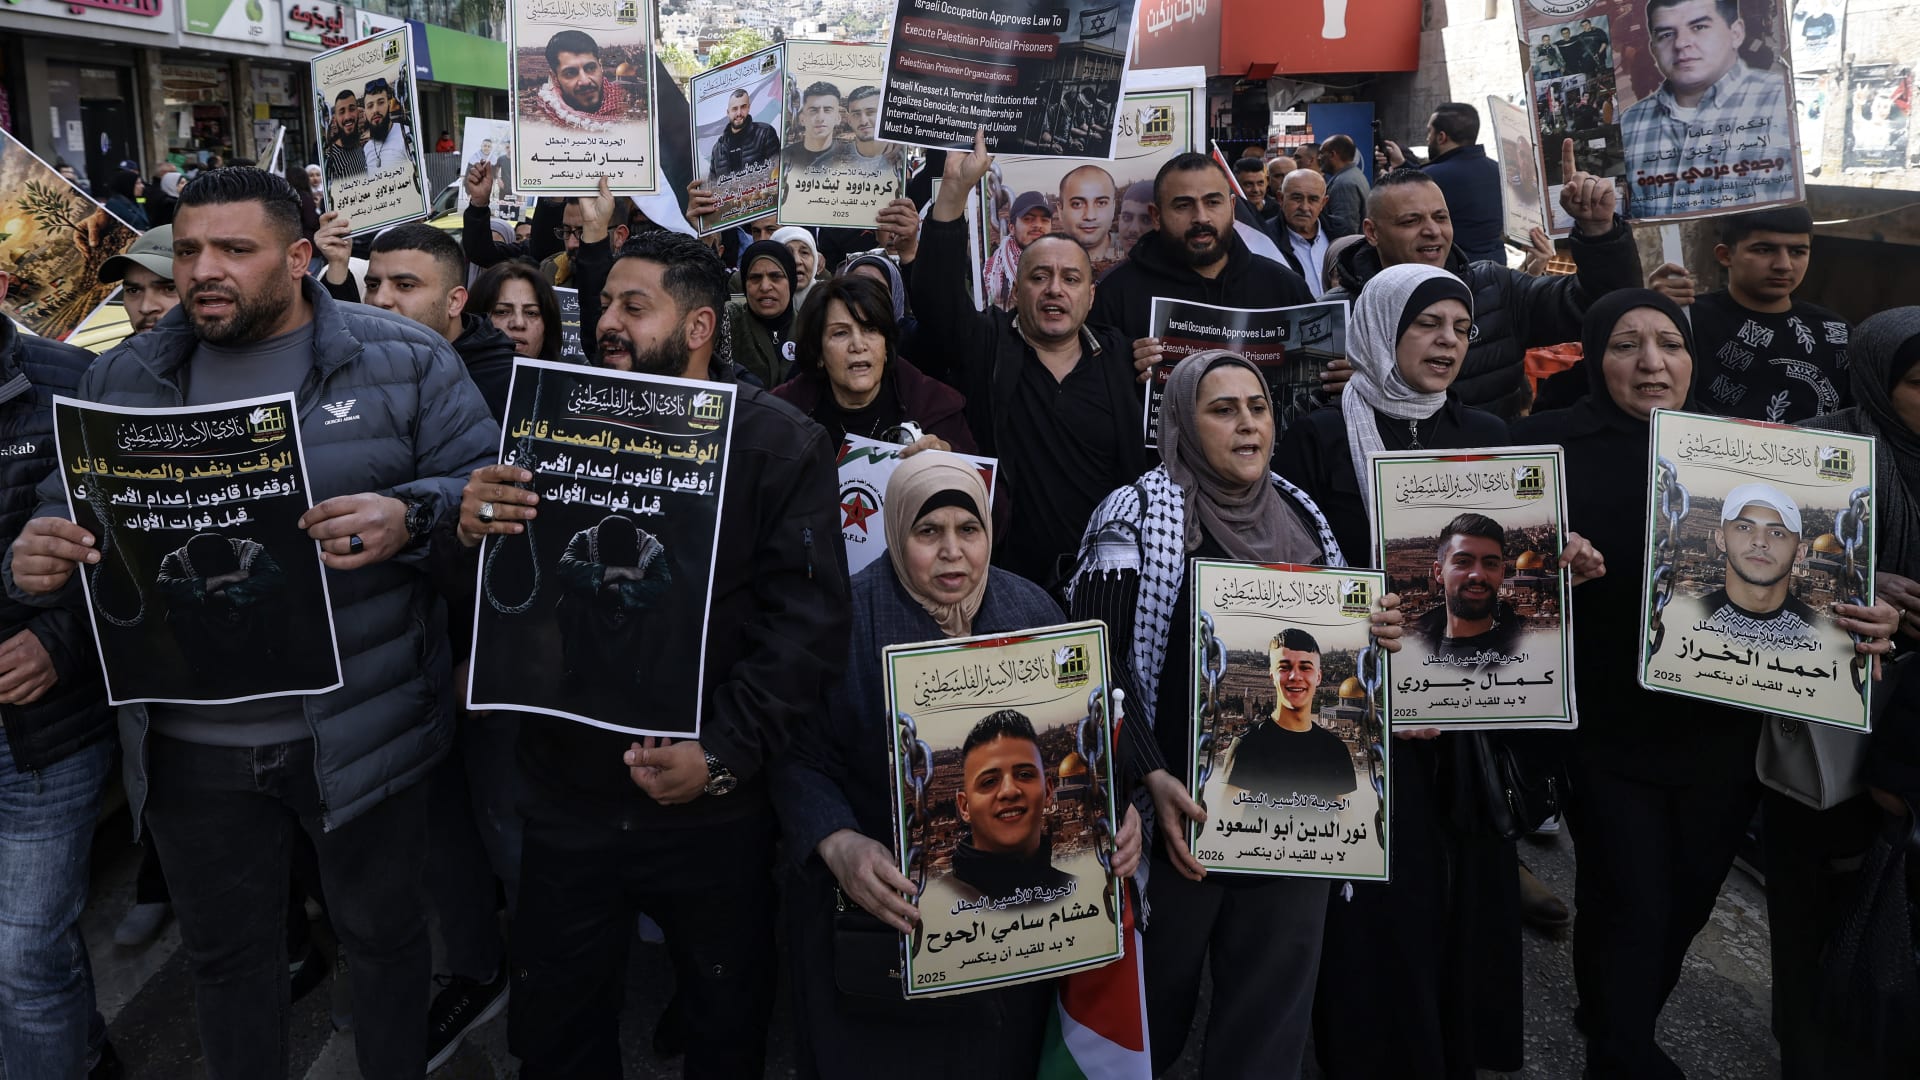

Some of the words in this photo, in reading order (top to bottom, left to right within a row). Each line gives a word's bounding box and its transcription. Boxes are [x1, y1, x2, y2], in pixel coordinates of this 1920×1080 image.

[914, 0, 940, 12] Israeli
[941, 2, 988, 21] Occupation
[989, 13, 1031, 28] Approves
[1033, 14, 1050, 26] Law
[1052, 15, 1062, 26] To
[905, 23, 935, 37] Execute
[936, 28, 979, 46] Palestinian
[980, 36, 1012, 50] Political
[1013, 40, 1053, 52] Prisoners
[900, 56, 934, 72] Palestinian
[935, 62, 964, 76] Prisoner
[964, 66, 1012, 82] Organizations:
[890, 78, 913, 91] Israeli
[914, 82, 942, 96] Knesset
[943, 87, 950, 96] A
[950, 88, 984, 102] Terrorist
[984, 93, 1022, 105] Institution
[1022, 95, 1038, 105] that
[888, 92, 923, 109] Legalizes
[924, 98, 959, 114] Genocide:
[960, 104, 969, 115] its
[970, 104, 1014, 121] Membership
[1016, 110, 1022, 118] in
[886, 108, 933, 124] International
[934, 114, 978, 130] Parliaments
[978, 120, 992, 132] and
[992, 122, 1017, 132] Unions
[1117, 113, 1134, 137] ناد
[884, 121, 901, 133] Must
[902, 124, 913, 135] be
[914, 126, 956, 141] Terminated
[956, 130, 999, 146] Immeately
[530, 152, 596, 166] اشتيه
[599, 152, 644, 166] يسار
[1732, 156, 1784, 176] وجدي
[1636, 170, 1679, 188] جودة
[1681, 159, 1730, 184] عزمي
[523, 178, 542, 186] 2025
[795, 178, 820, 192] داوود
[822, 178, 840, 193] ليث
[846, 180, 870, 194] داوود
[873, 180, 893, 196] كرم
[1169, 318, 1188, 331] Israeli
[1188, 320, 1220, 336] Occupation
[1222, 326, 1260, 340] Approves
[1260, 327, 1276, 338] Law
[1277, 326, 1285, 337] To
[1162, 342, 1184, 354] Execute
[1246, 350, 1280, 361] Prisoners
[9, 442, 36, 456] Rab
[552, 430, 621, 454] والصمت
[624, 436, 663, 458] ينفد
[237, 451, 292, 472] الوقت
[668, 444, 719, 466] الوقت
[112, 463, 185, 483] والصمت
[190, 460, 232, 478] ينفد
[574, 462, 618, 485] إعدام
[622, 468, 663, 487] قانون
[245, 475, 296, 500] أوقفوا
[666, 470, 715, 496] أوقفوا
[146, 490, 192, 510] إعدام
[196, 484, 241, 506] قانون
[546, 482, 586, 504] الأوان
[590, 490, 630, 512] فوات
[632, 495, 661, 517] قبل
[126, 513, 164, 532] الأوان
[169, 511, 213, 532] فوات
[217, 507, 248, 528] قبل
[1692, 618, 1730, 636] البطل
[1674, 636, 1760, 668] الخراز
[1778, 634, 1822, 652] الحرية
[1422, 654, 1454, 666] البطل
[1493, 652, 1529, 664] الحرية
[1654, 670, 1682, 683] 2025
[1694, 668, 1734, 684] ينكسر
[1766, 656, 1838, 682] أحمد
[1397, 676, 1476, 694] جوري
[1480, 670, 1554, 690] كمال
[1736, 673, 1748, 686] أن
[1752, 679, 1784, 692] للقيد
[1518, 696, 1526, 704] لا
[1787, 686, 1802, 697] بد
[1806, 687, 1816, 698] لا
[1427, 697, 1460, 709] ينكسر
[1462, 696, 1472, 708] أن
[1474, 696, 1500, 708] للقيد
[1504, 699, 1516, 708] بد
[1394, 708, 1418, 717] 2025
[1232, 792, 1268, 810] البطل
[1310, 794, 1350, 812] الحرية
[1216, 816, 1268, 838] السعود
[1270, 814, 1294, 842] أبو
[1296, 818, 1340, 843] الدين
[1341, 822, 1368, 845] نور
[1198, 850, 1224, 862] 2026
[1236, 847, 1272, 862] ينكسر
[1274, 846, 1286, 860] أن
[1288, 850, 1317, 863] للقيد
[1320, 853, 1334, 864] بد
[1336, 850, 1346, 862] لا
[1036, 880, 1078, 900] الحرية
[951, 896, 989, 916] البطل
[1049, 902, 1100, 932] هشام
[926, 920, 986, 953] الحوح
[990, 914, 1044, 944] سامي
[1014, 942, 1046, 958] للقيد
[1048, 940, 1062, 953] بد
[1065, 936, 1076, 947] لا
[958, 952, 998, 970] ينكسر
[1000, 946, 1012, 962] أن
[917, 972, 946, 984] 2025
